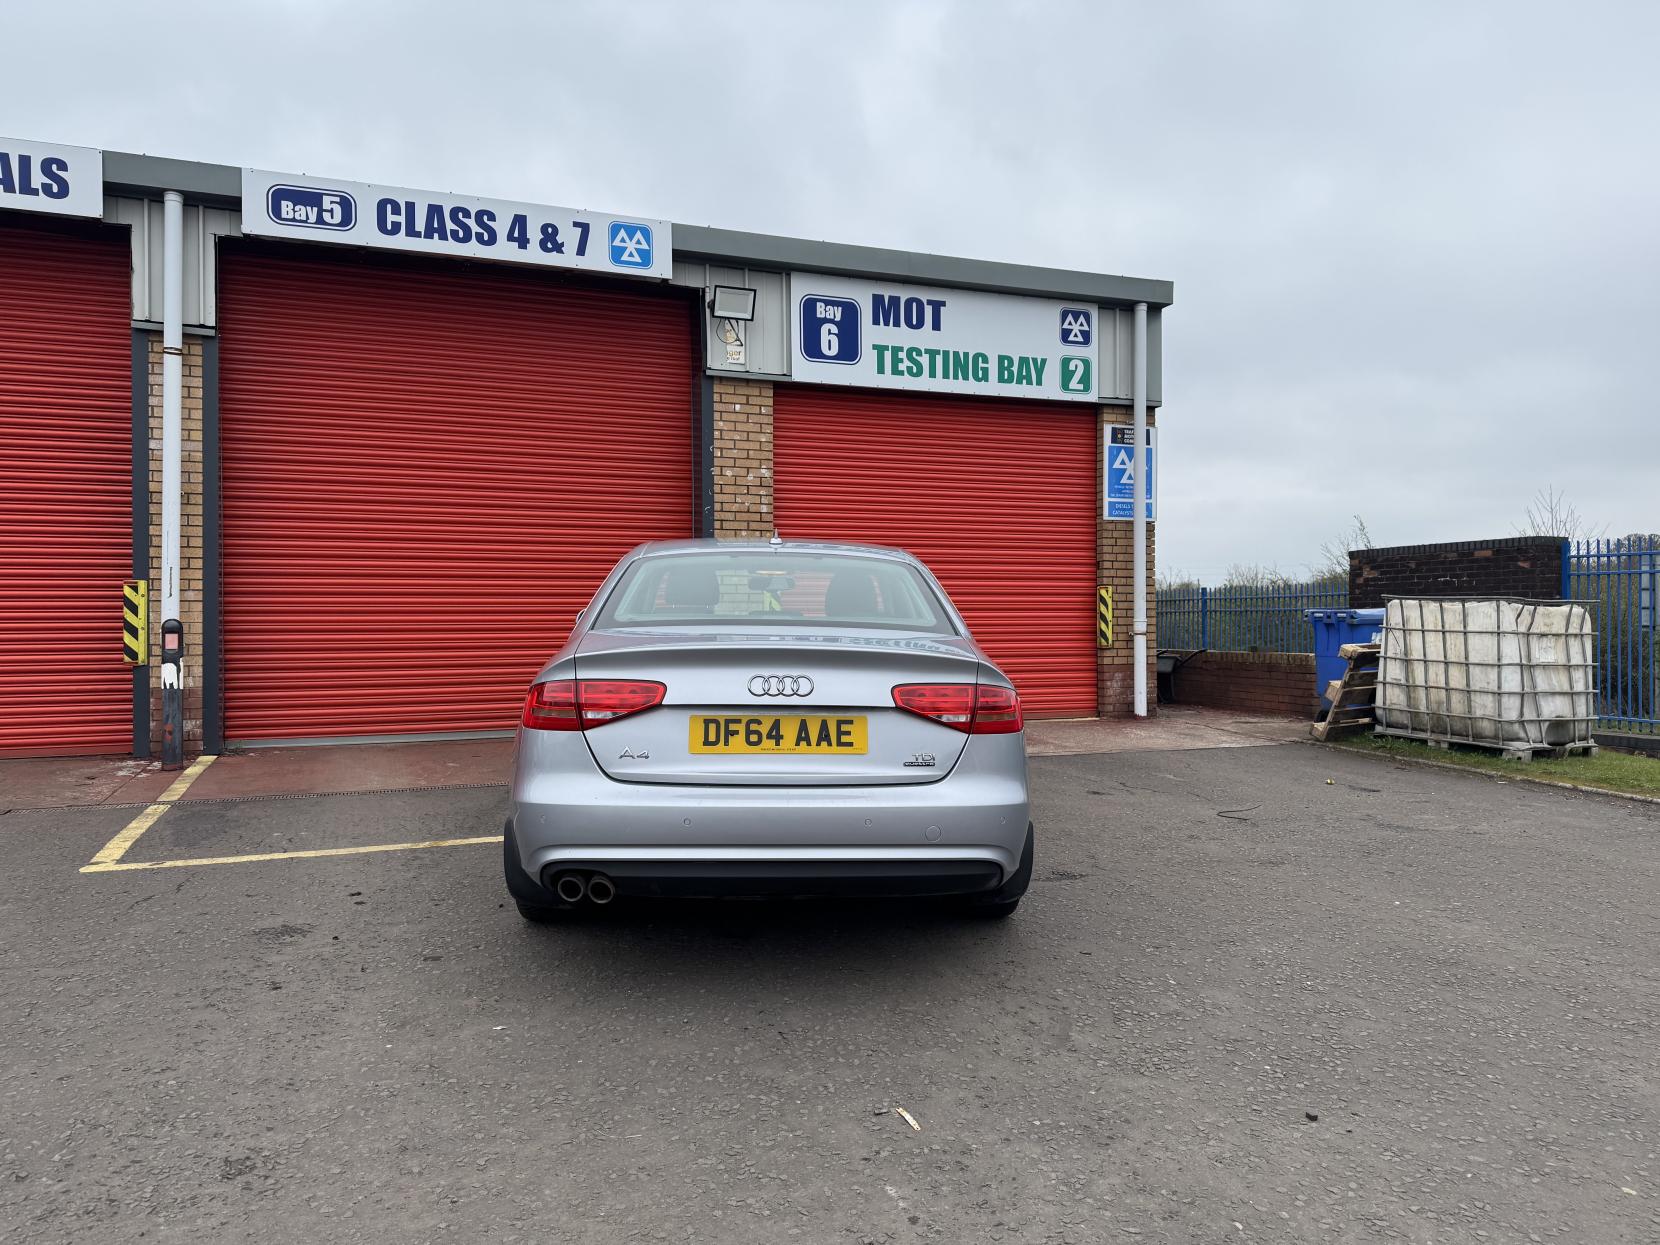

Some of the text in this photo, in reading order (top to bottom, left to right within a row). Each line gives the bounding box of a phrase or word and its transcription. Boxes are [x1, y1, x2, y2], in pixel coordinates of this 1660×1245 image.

[280, 195, 342, 225] Bay 5
[376, 197, 591, 257] CLASS 4 & 7
[816, 301, 843, 322] Bay
[871, 293, 947, 332] MOT
[820, 322, 840, 357] 6
[871, 343, 1085, 391] TESTING BAY 2
[702, 718, 854, 748] DF64 AAE
[618, 745, 650, 760] A4
